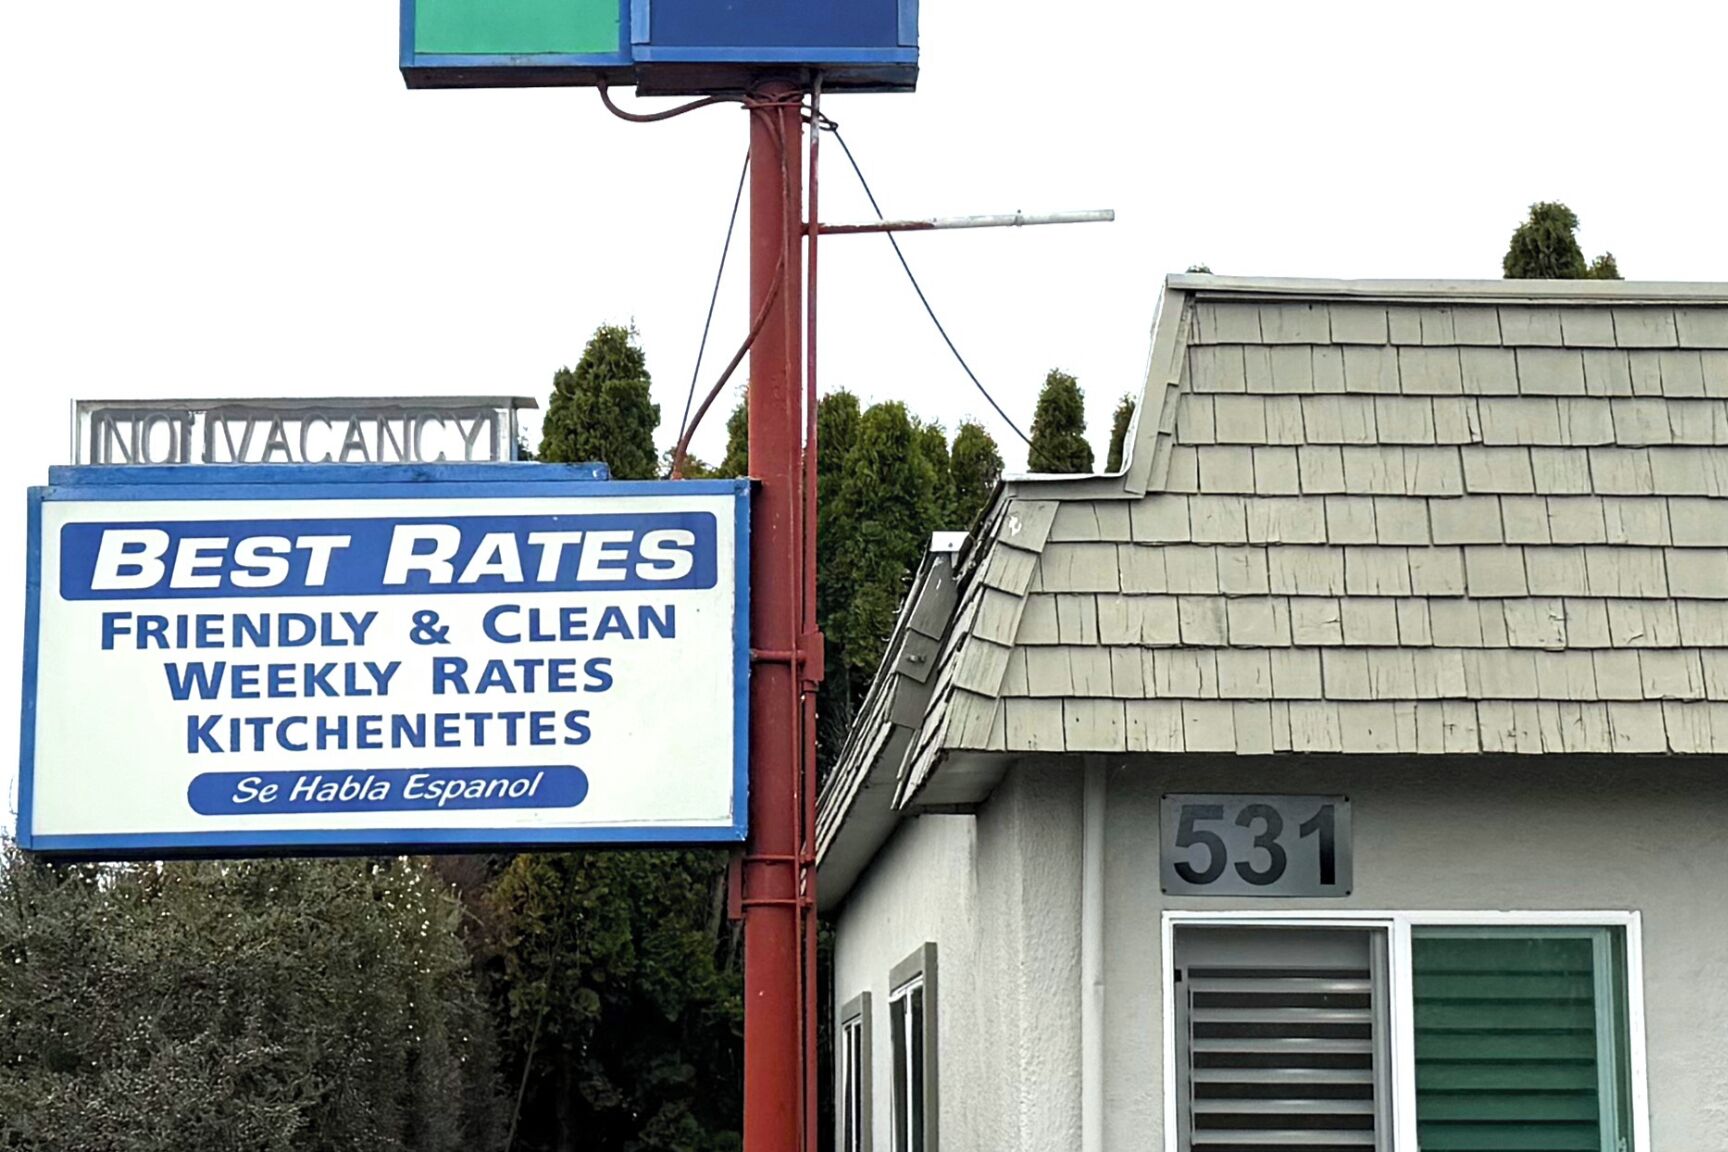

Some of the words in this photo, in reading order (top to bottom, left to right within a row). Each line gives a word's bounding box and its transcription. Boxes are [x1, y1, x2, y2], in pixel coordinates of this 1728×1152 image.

[103, 411, 179, 464] NO
[218, 410, 487, 464] VACANCY
[91, 529, 351, 590] BEST
[383, 524, 696, 585] RATES
[101, 611, 379, 650] FRIENDLY
[410, 609, 451, 645] &
[483, 604, 677, 643] CLEAN
[163, 661, 402, 701] WEEKLY
[432, 656, 614, 695] RATES
[187, 710, 592, 754] KITCHENETTES
[232, 776, 279, 804] Se
[289, 775, 391, 803] Habla
[404, 771, 544, 808] Espanol
[1173, 803, 1336, 886] 531
